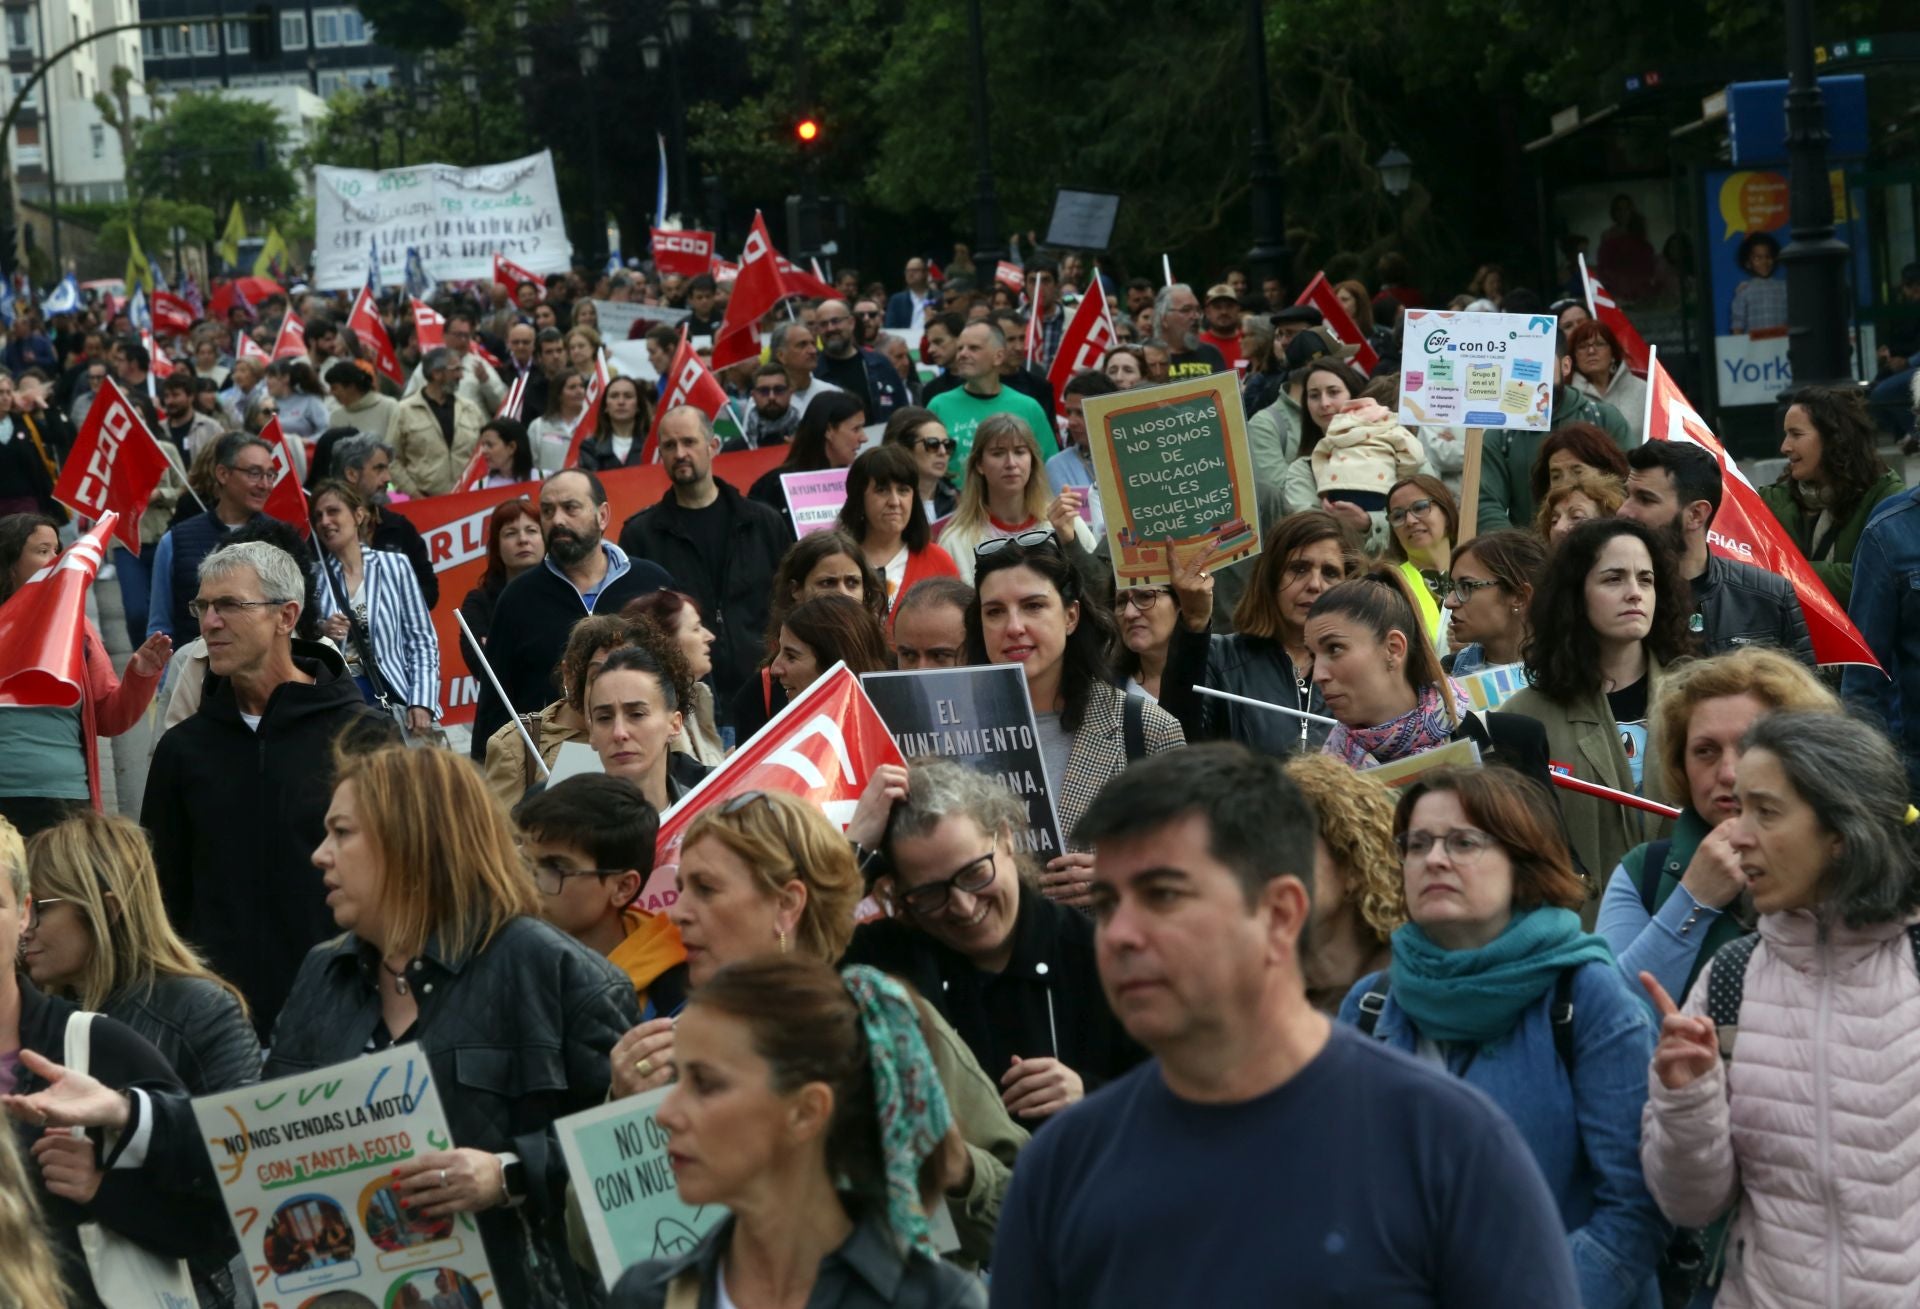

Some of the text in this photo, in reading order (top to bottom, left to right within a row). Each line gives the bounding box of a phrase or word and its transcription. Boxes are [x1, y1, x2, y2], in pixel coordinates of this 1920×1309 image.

[653, 235, 709, 256] CCOO
[1459, 342, 1483, 352] con
[1487, 341, 1507, 353] 0-3
[1472, 371, 1492, 379] Grupo
[1112, 406, 1218, 440] SI NOSOTRAS
[1126, 425, 1211, 454] NO SOMOS
[1128, 456, 1225, 487] EDUCACIÓN,
[1161, 448, 1184, 464] DE
[1143, 502, 1233, 537] ¿QUÉ SON?
[937, 700, 961, 725] EL
[893, 726, 1033, 757] YUNTAMIENTO
[224, 1094, 415, 1155] NO NOS VENDAS LA MOTO
[613, 1121, 644, 1161] NO
[256, 1131, 411, 1183] CON TANTA FOTO
[594, 1155, 676, 1212] CON NUE
